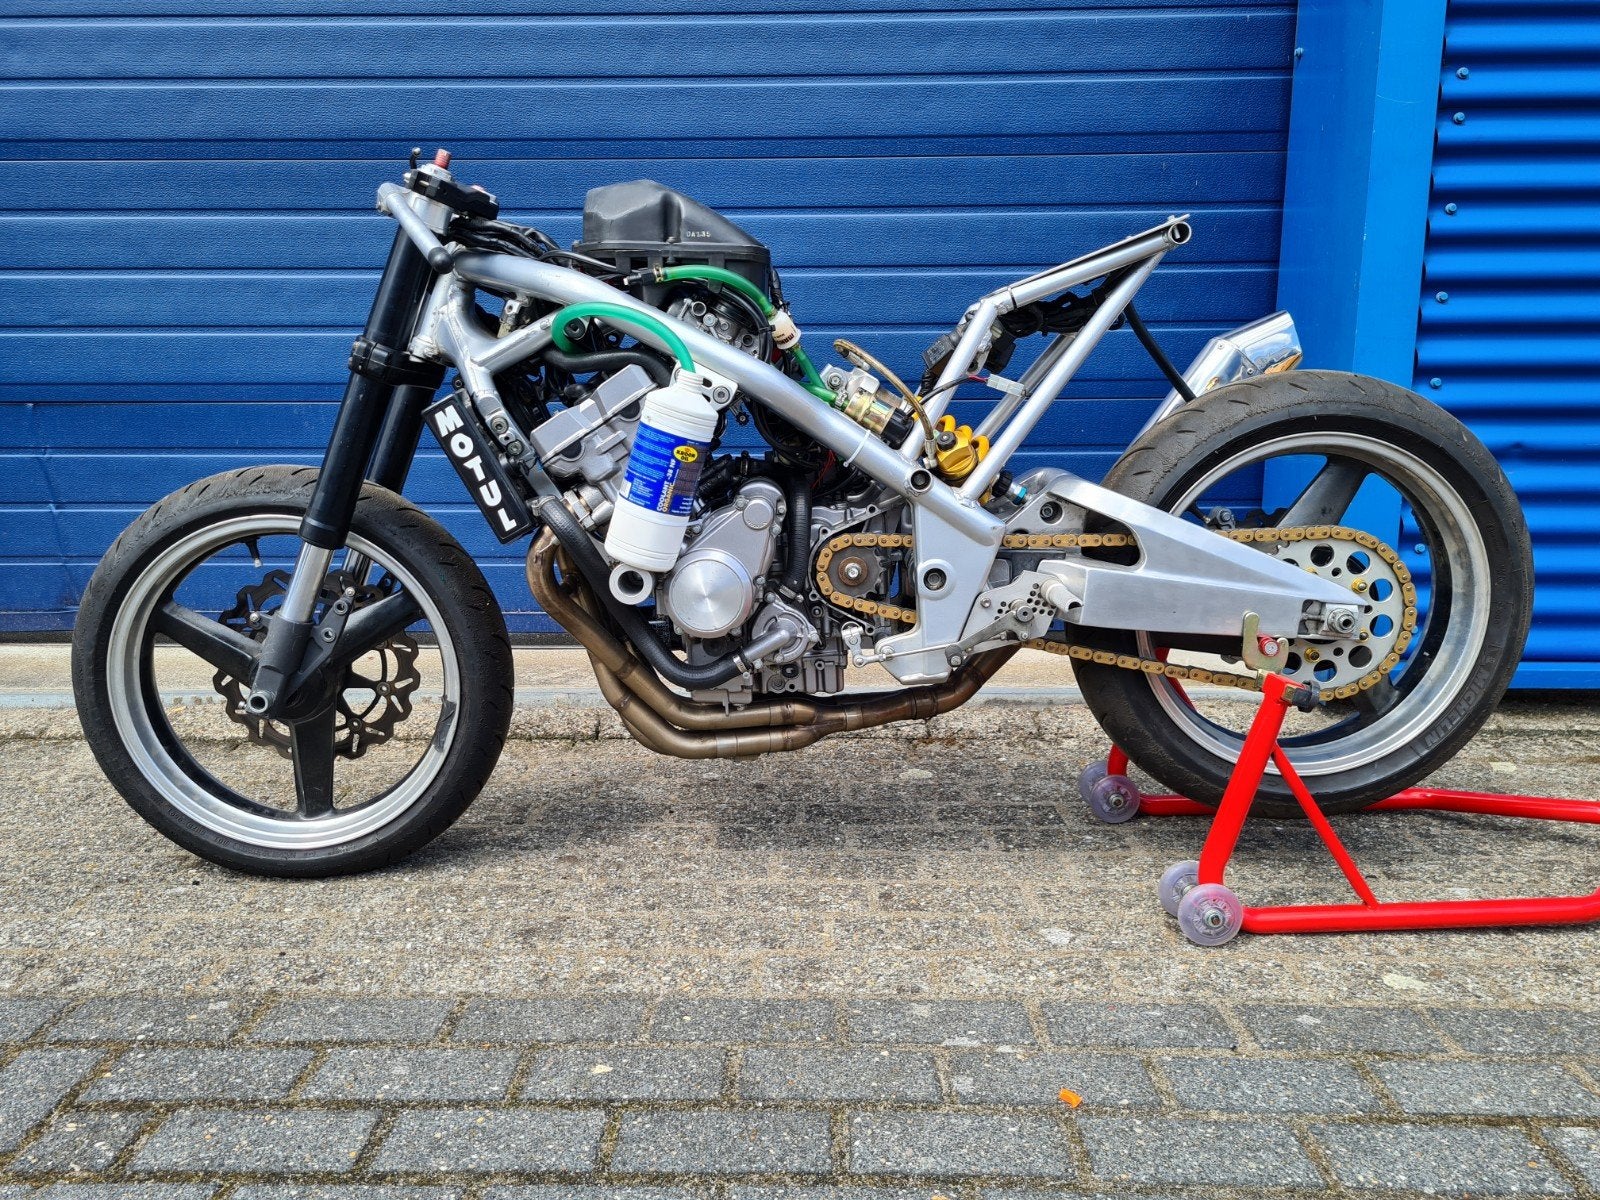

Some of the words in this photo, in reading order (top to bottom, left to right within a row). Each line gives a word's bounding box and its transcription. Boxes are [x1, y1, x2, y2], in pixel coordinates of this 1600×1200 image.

[434, 404, 517, 532] MOTUL
[657, 481, 670, 511] COOLANT
[1425, 667, 1492, 748] MICHELIN
